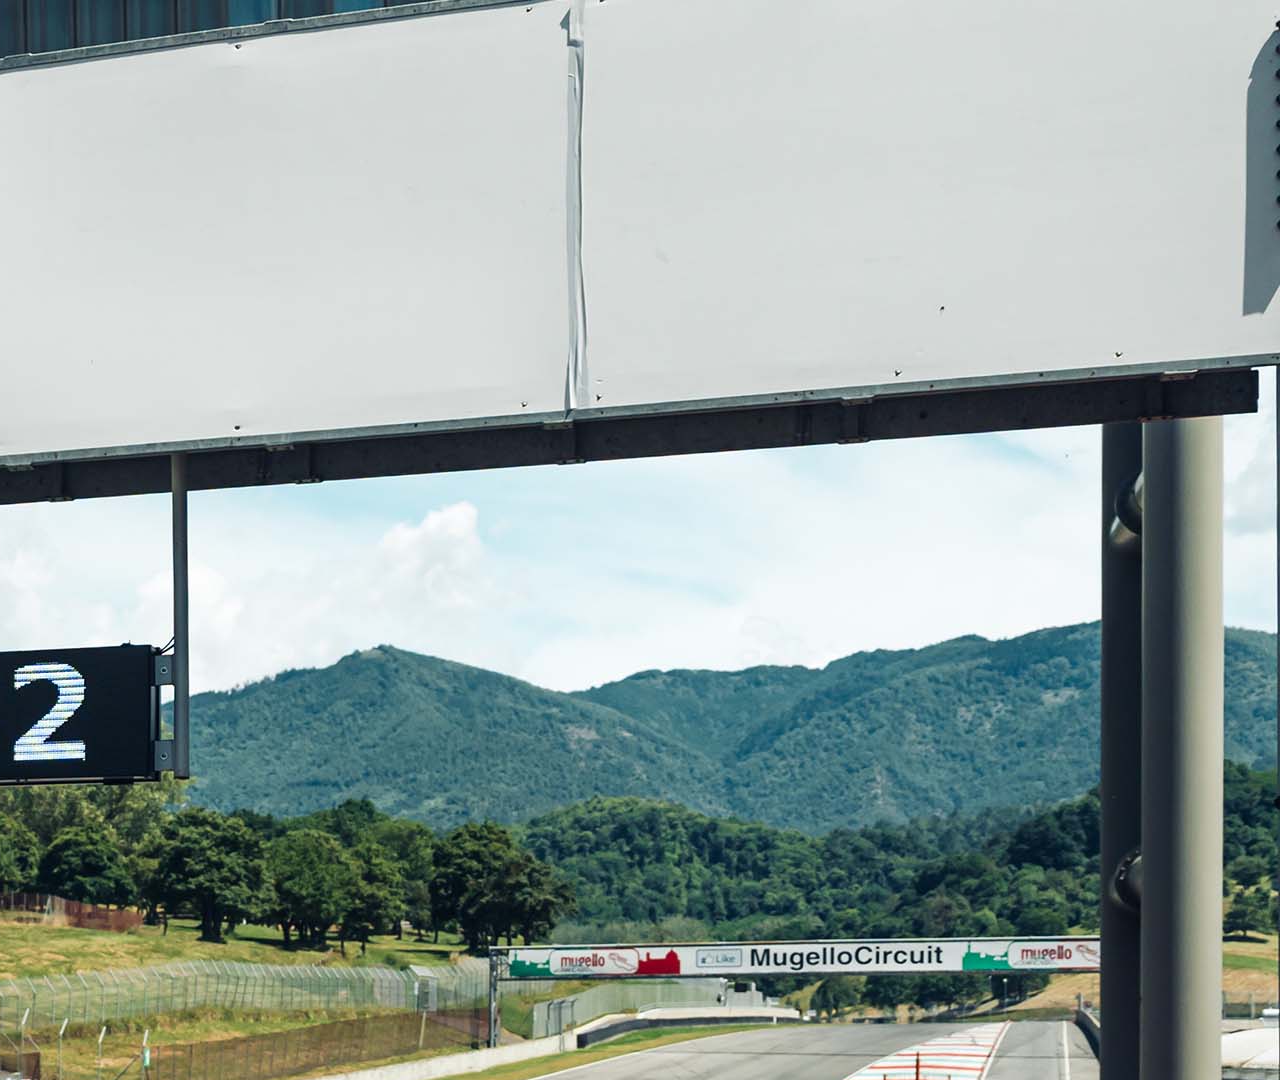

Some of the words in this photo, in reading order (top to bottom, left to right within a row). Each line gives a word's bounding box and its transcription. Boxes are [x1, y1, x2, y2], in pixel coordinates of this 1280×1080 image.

[560, 952, 605, 968] mugello
[715, 952, 736, 964] Like
[749, 945, 944, 970] MugelloCircuit
[1020, 945, 1073, 961] mugello
